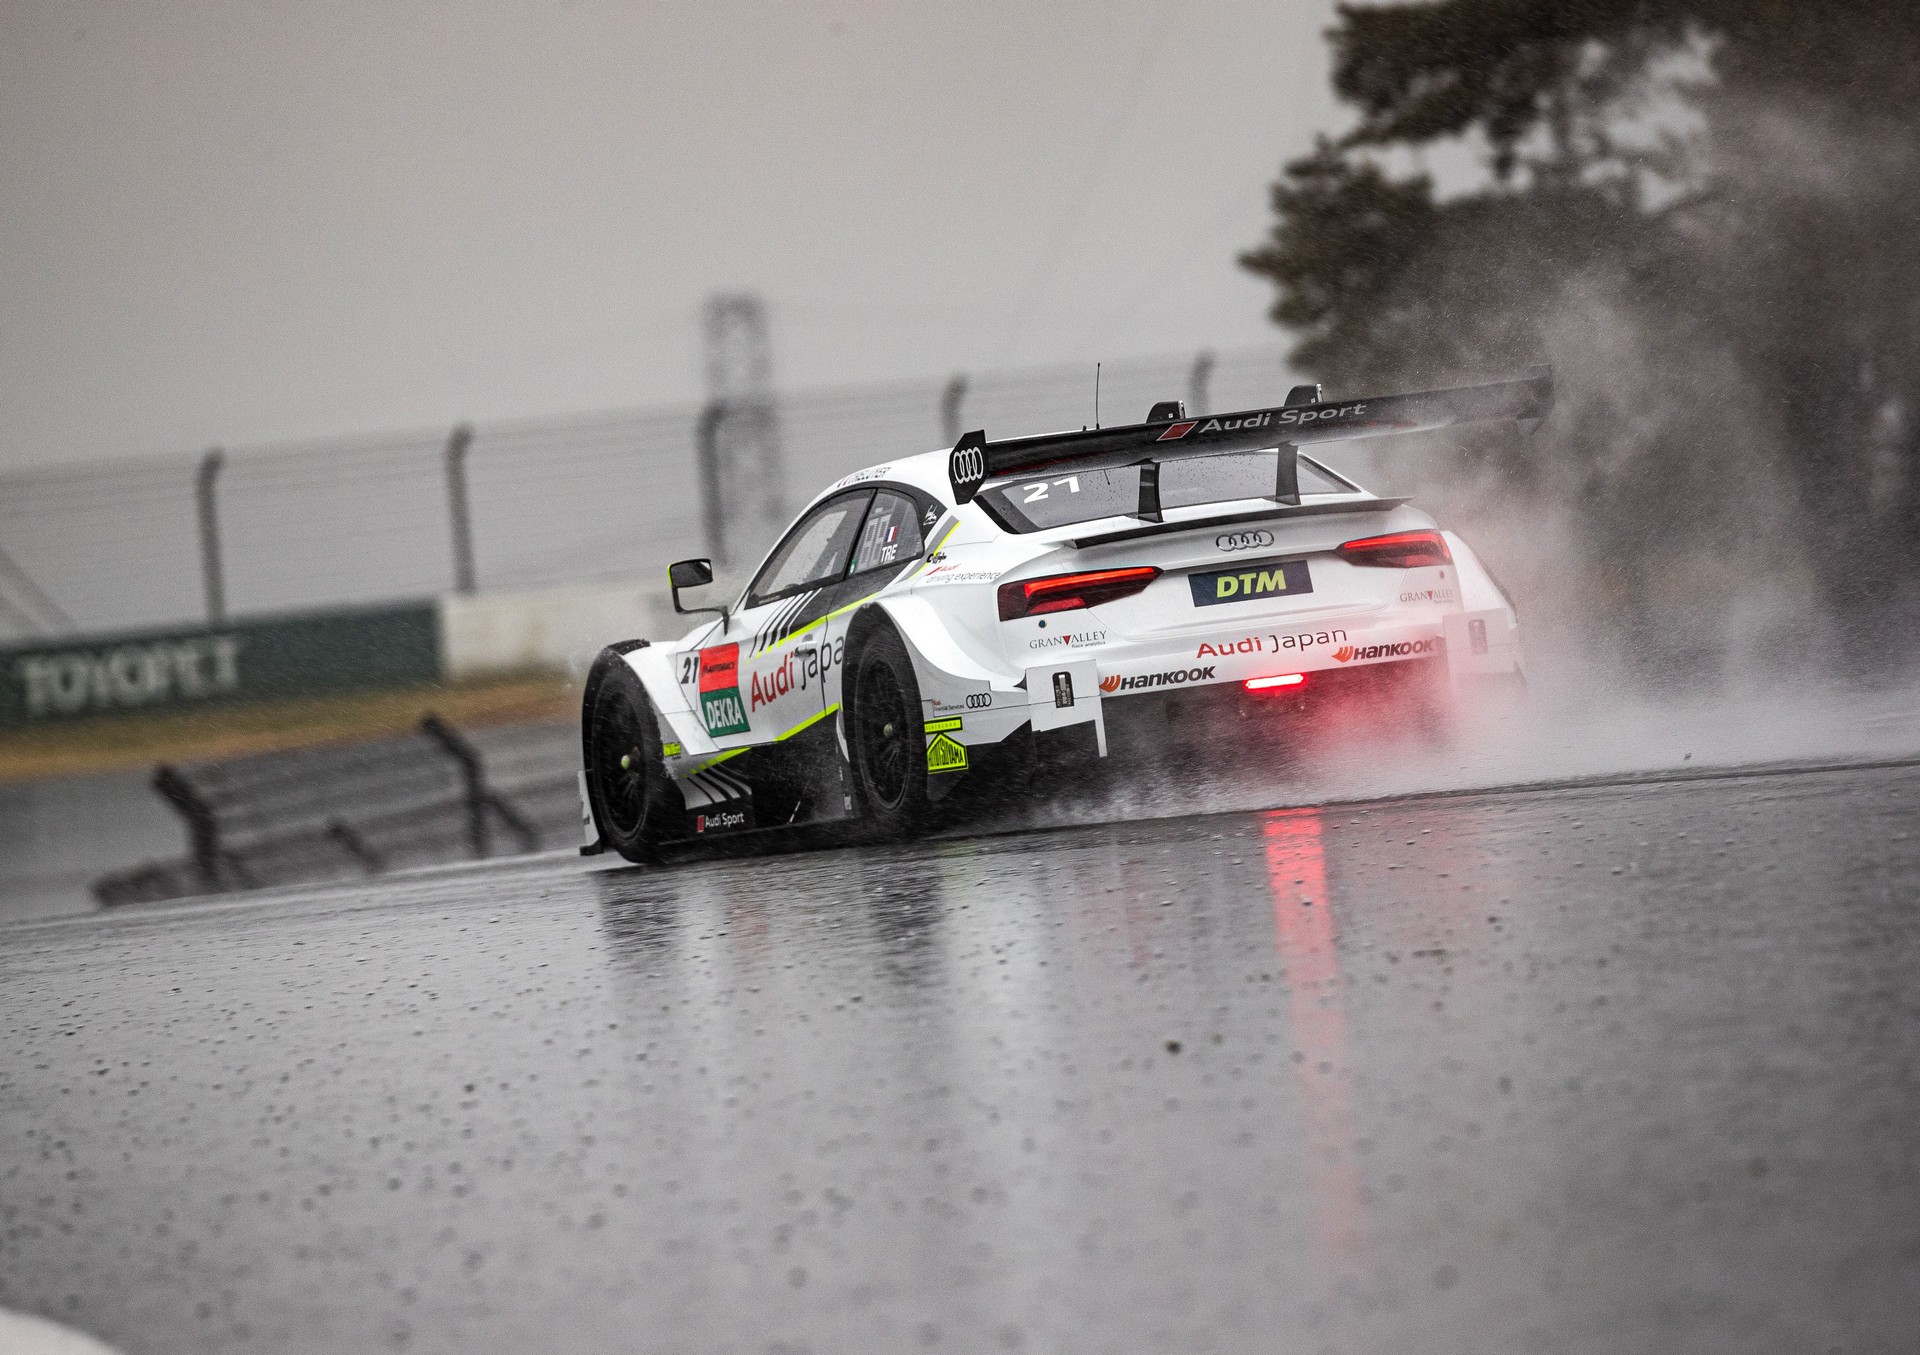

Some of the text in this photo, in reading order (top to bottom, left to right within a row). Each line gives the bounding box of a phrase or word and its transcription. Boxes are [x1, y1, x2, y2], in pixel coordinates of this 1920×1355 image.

[1199, 403, 1367, 433] Audi Sport
[1023, 476, 1080, 504] 21
[880, 544, 899, 563] TRE
[954, 571, 1002, 582] experience
[1216, 569, 1287, 598] DTM
[1196, 629, 1348, 659] Audi Japan
[681, 656, 699, 684] 21
[751, 636, 845, 712] Audi Japa
[707, 697, 744, 730] DEKRA
[705, 812, 745, 829] Audi Sport
